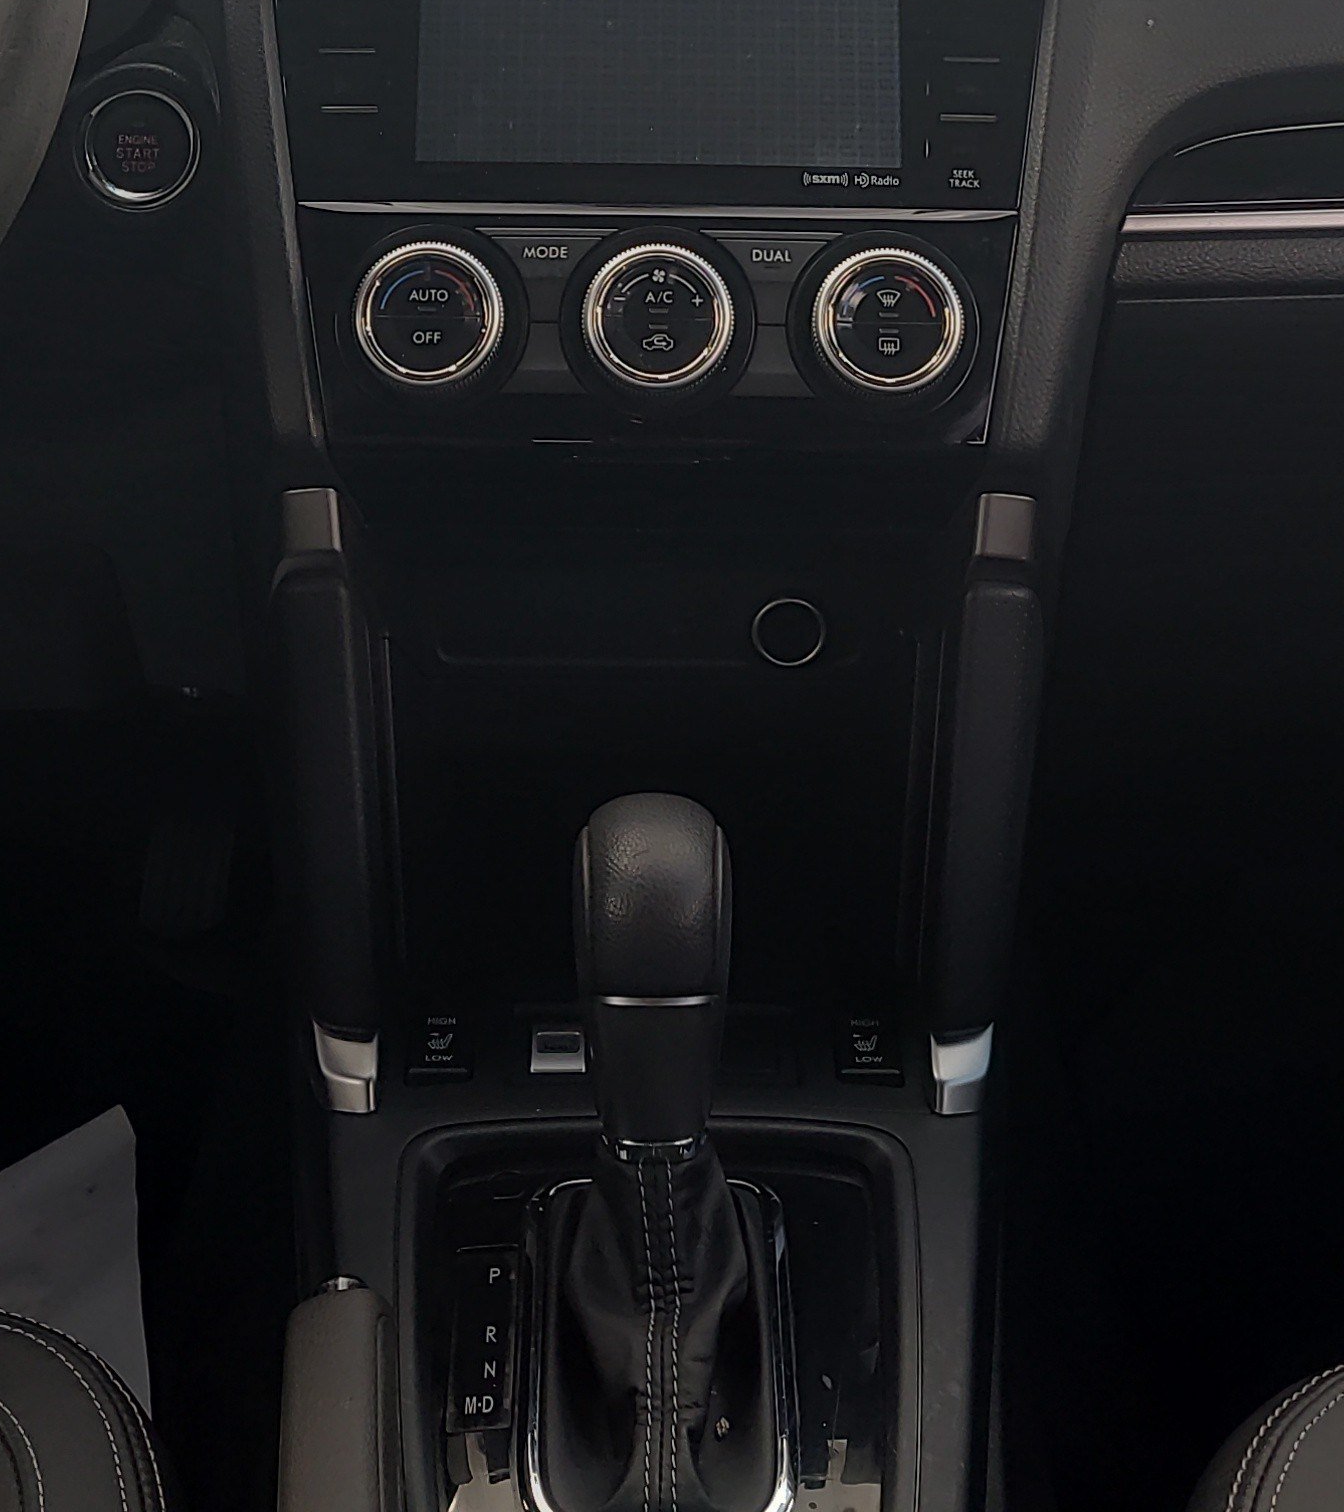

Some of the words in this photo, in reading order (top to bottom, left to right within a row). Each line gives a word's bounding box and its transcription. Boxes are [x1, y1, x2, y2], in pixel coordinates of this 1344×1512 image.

[117, 134, 159, 145] ENGINE
[116, 148, 160, 159] START
[121, 162, 156, 173] STOP
[952, 169, 974, 179] SEEK
[871, 175, 899, 186] Radio
[948, 178, 980, 188] TRACK
[522, 246, 568, 260] MODE
[751, 249, 792, 263] DUAL
[408, 289, 449, 302] AUTO
[644, 291, 674, 304] A/C
[412, 331, 442, 345] OFF
[425, 1054, 453, 1062] LOW
[488, 1267, 501, 1284] P
[485, 1326, 497, 1344] R
[484, 1360, 496, 1378] N
